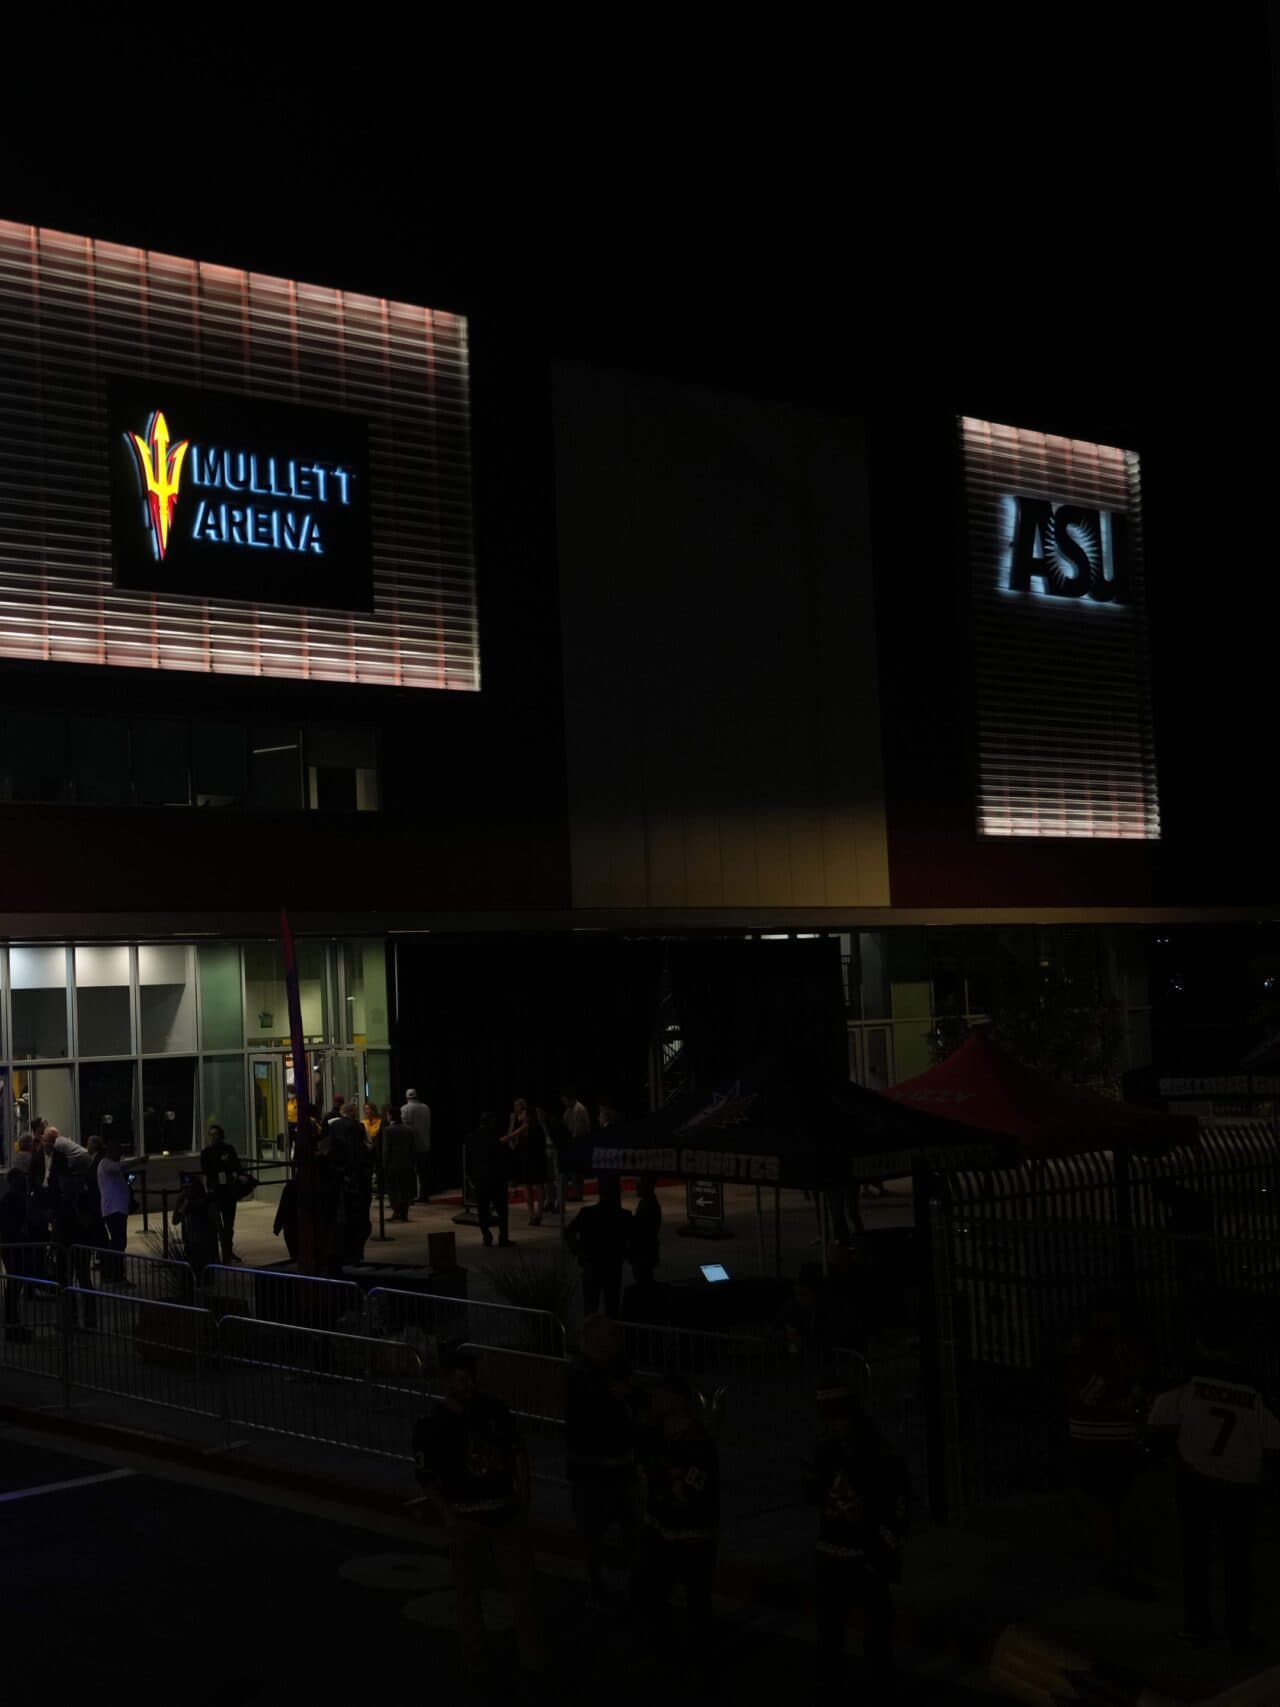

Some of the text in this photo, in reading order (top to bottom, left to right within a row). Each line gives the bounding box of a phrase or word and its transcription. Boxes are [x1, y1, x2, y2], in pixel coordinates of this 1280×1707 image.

[191, 445, 351, 505] MULLETT
[191, 500, 325, 554] ARENA
[1000, 496, 1131, 604] ASU
